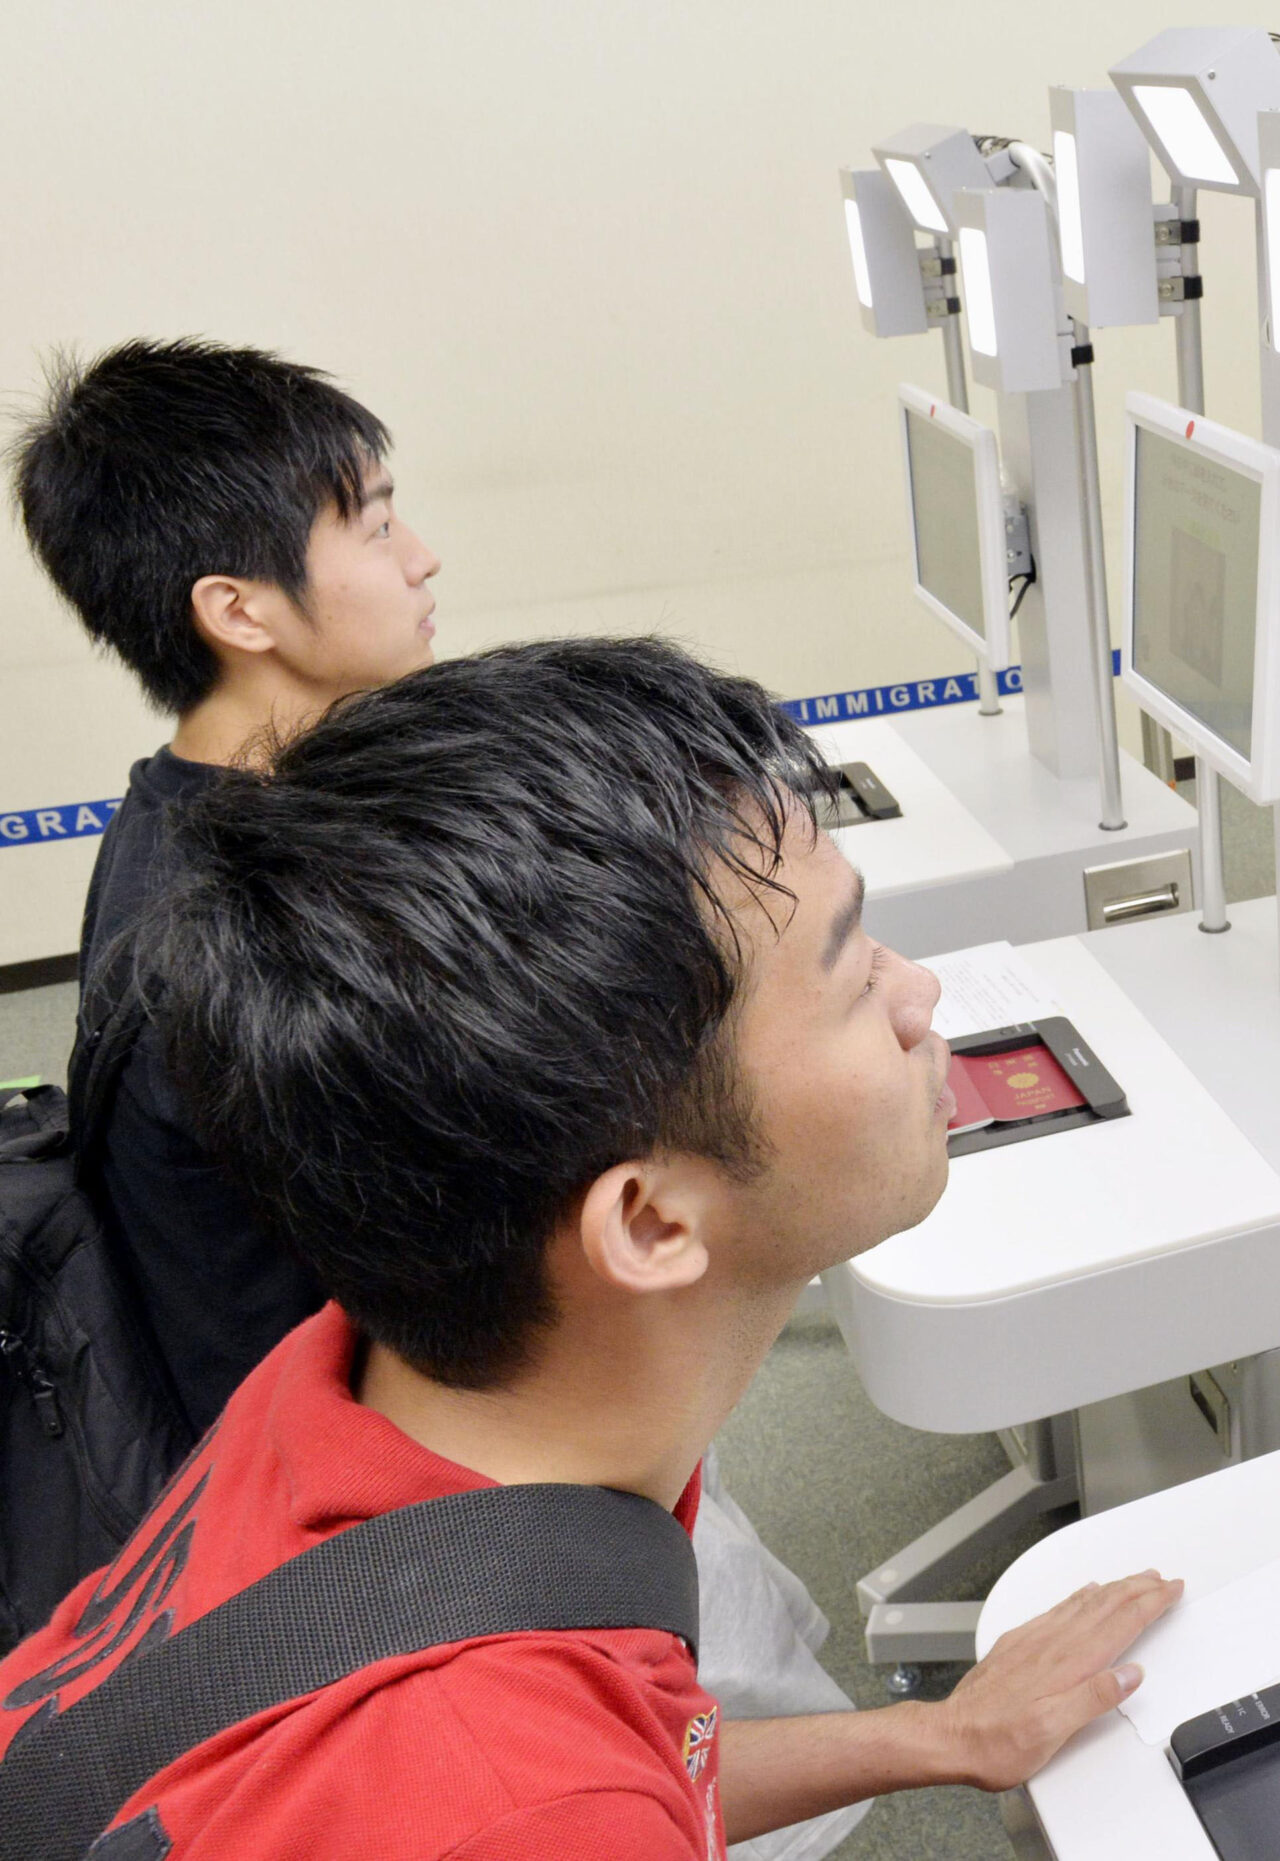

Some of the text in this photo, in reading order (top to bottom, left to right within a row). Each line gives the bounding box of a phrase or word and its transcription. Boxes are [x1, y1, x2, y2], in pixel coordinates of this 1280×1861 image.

[802, 669, 1023, 721] IMMIGRATO
[1255, 1700, 1270, 1720] ERROR
[1220, 1715, 1235, 1734] READY
